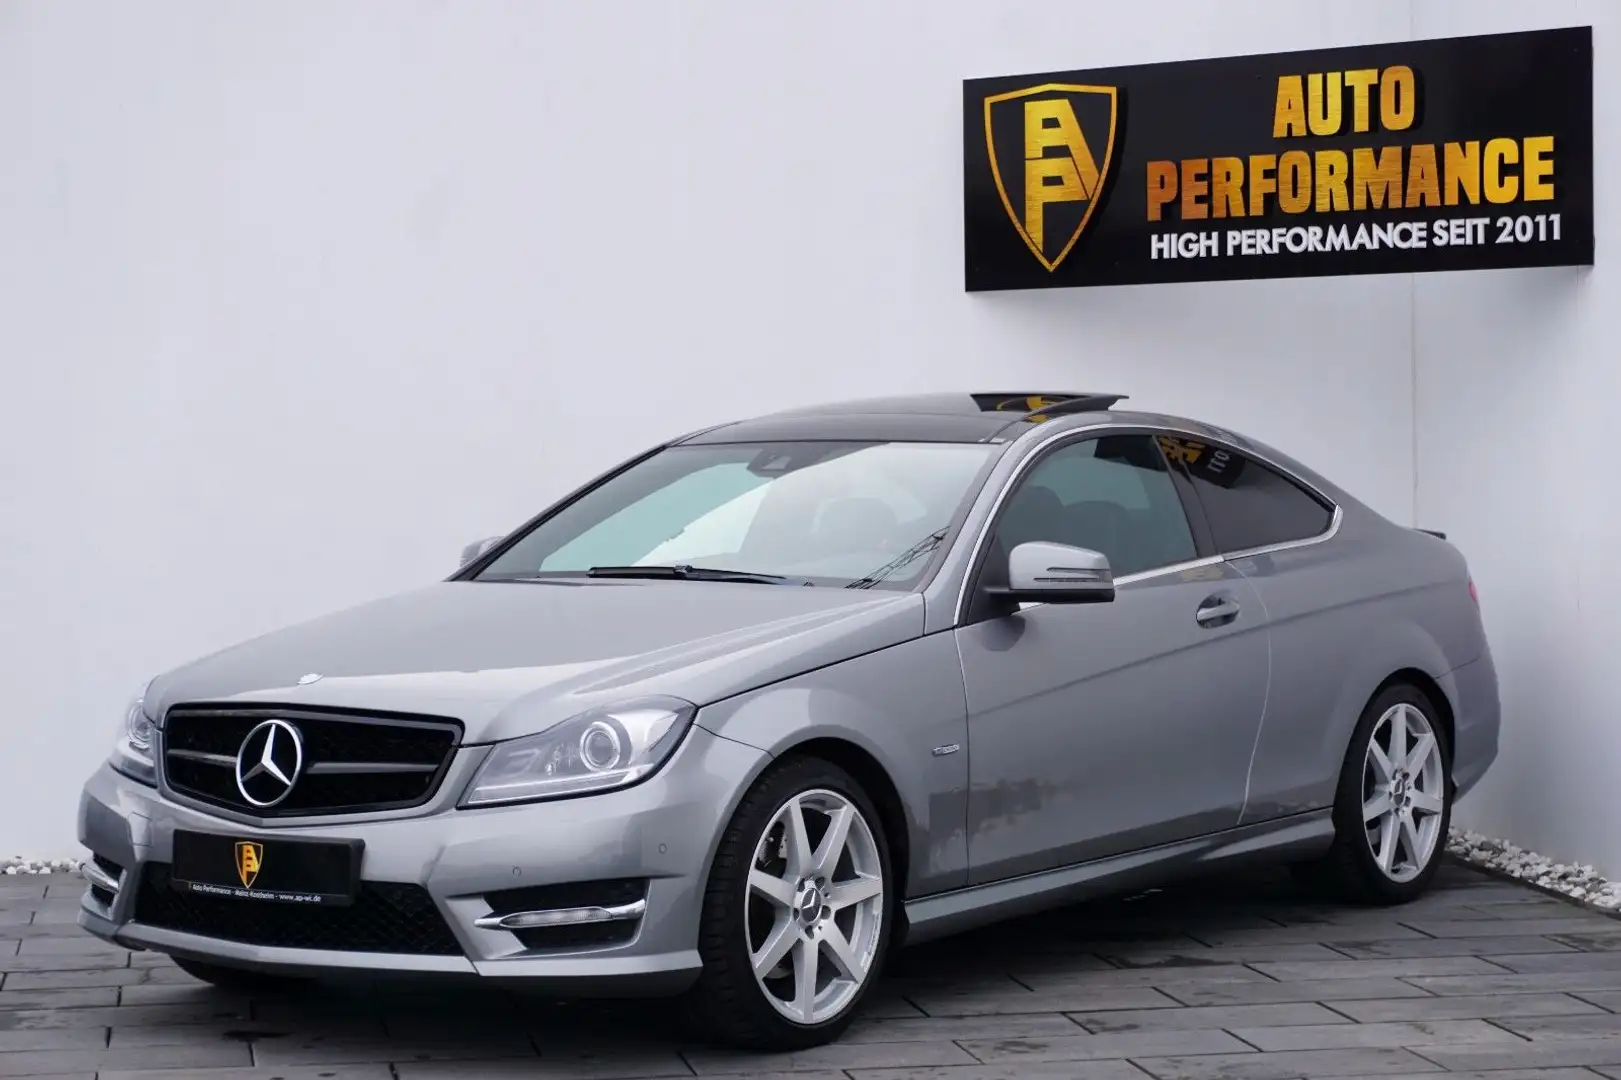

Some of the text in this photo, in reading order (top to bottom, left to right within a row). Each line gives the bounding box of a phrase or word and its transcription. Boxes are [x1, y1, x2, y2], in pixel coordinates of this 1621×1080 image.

[1272, 65, 1415, 138] AUTO
[1147, 136, 1554, 221] PERFORMANCE
[1151, 213, 1561, 259] HIGH PERFORMANCE SEIT 2011
